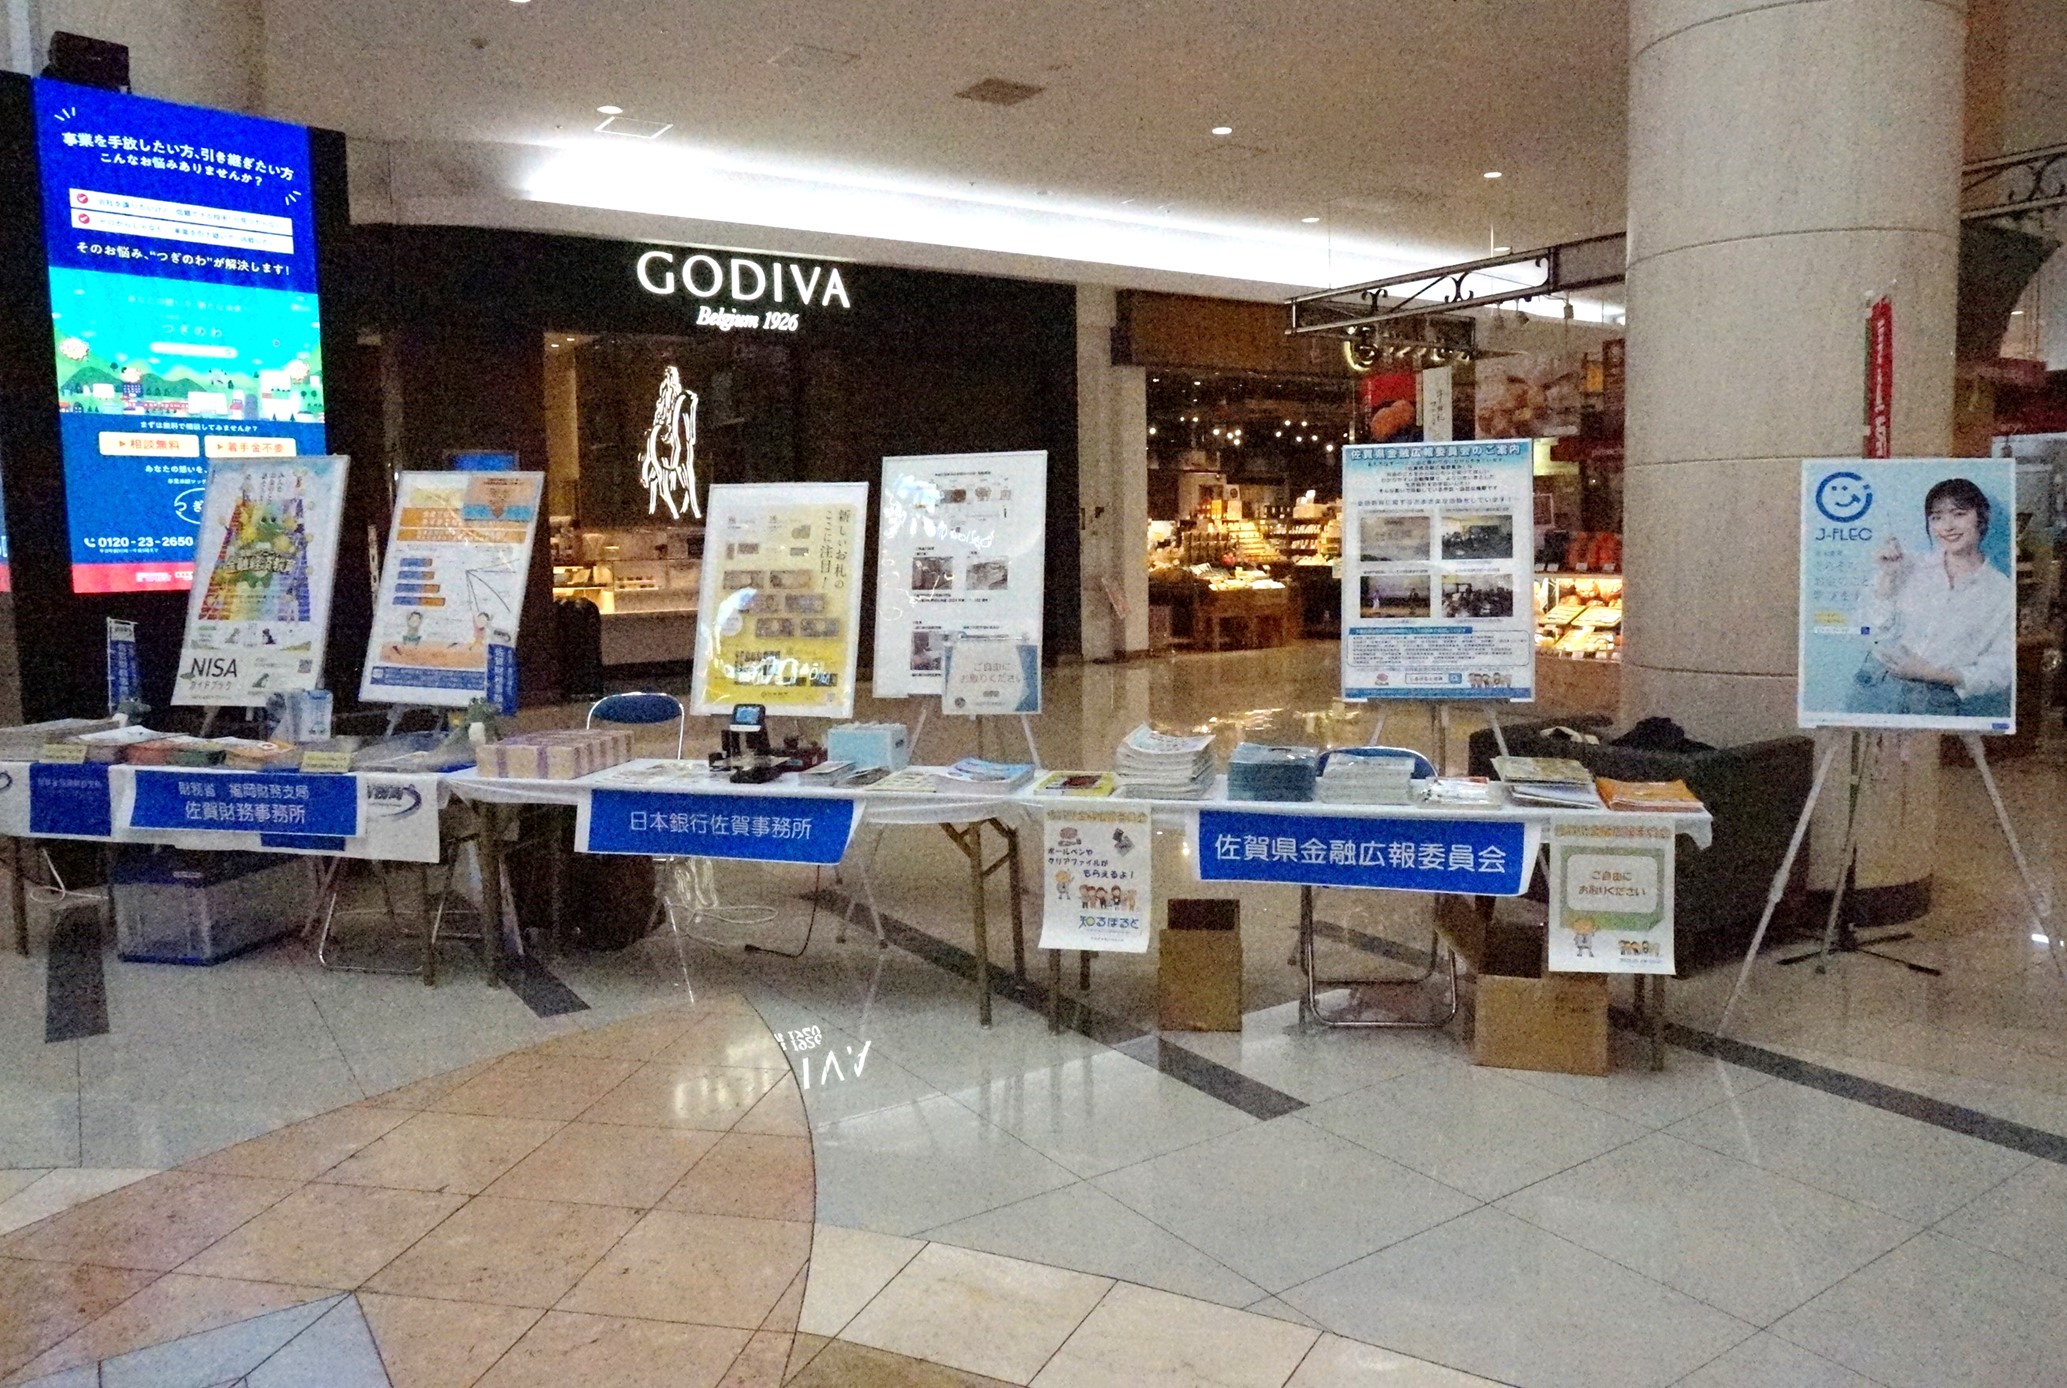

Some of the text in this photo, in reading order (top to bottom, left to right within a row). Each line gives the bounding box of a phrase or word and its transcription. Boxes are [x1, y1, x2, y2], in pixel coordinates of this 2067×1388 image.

[636, 250, 851, 309] GODIVA
[696, 305, 799, 332] Belgium 1926
[130, 439, 180, 451] 相談無料
[227, 441, 285, 454] 着手金不要
[98, 536, 194, 548] 0120-23-2650
[1815, 527, 1873, 541] J-FLEC
[834, 508, 852, 590] 新しいお札の
[190, 657, 238, 678] NISA
[185, 799, 307, 824] 佐賀財務事務所
[630, 809, 813, 840] 日本銀行佐賀事務所
[1215, 832, 1508, 875] 佐賀県金融広報委員会
[1591, 870, 1632, 882] ご自由に
[1578, 885, 1648, 897] お取りください
